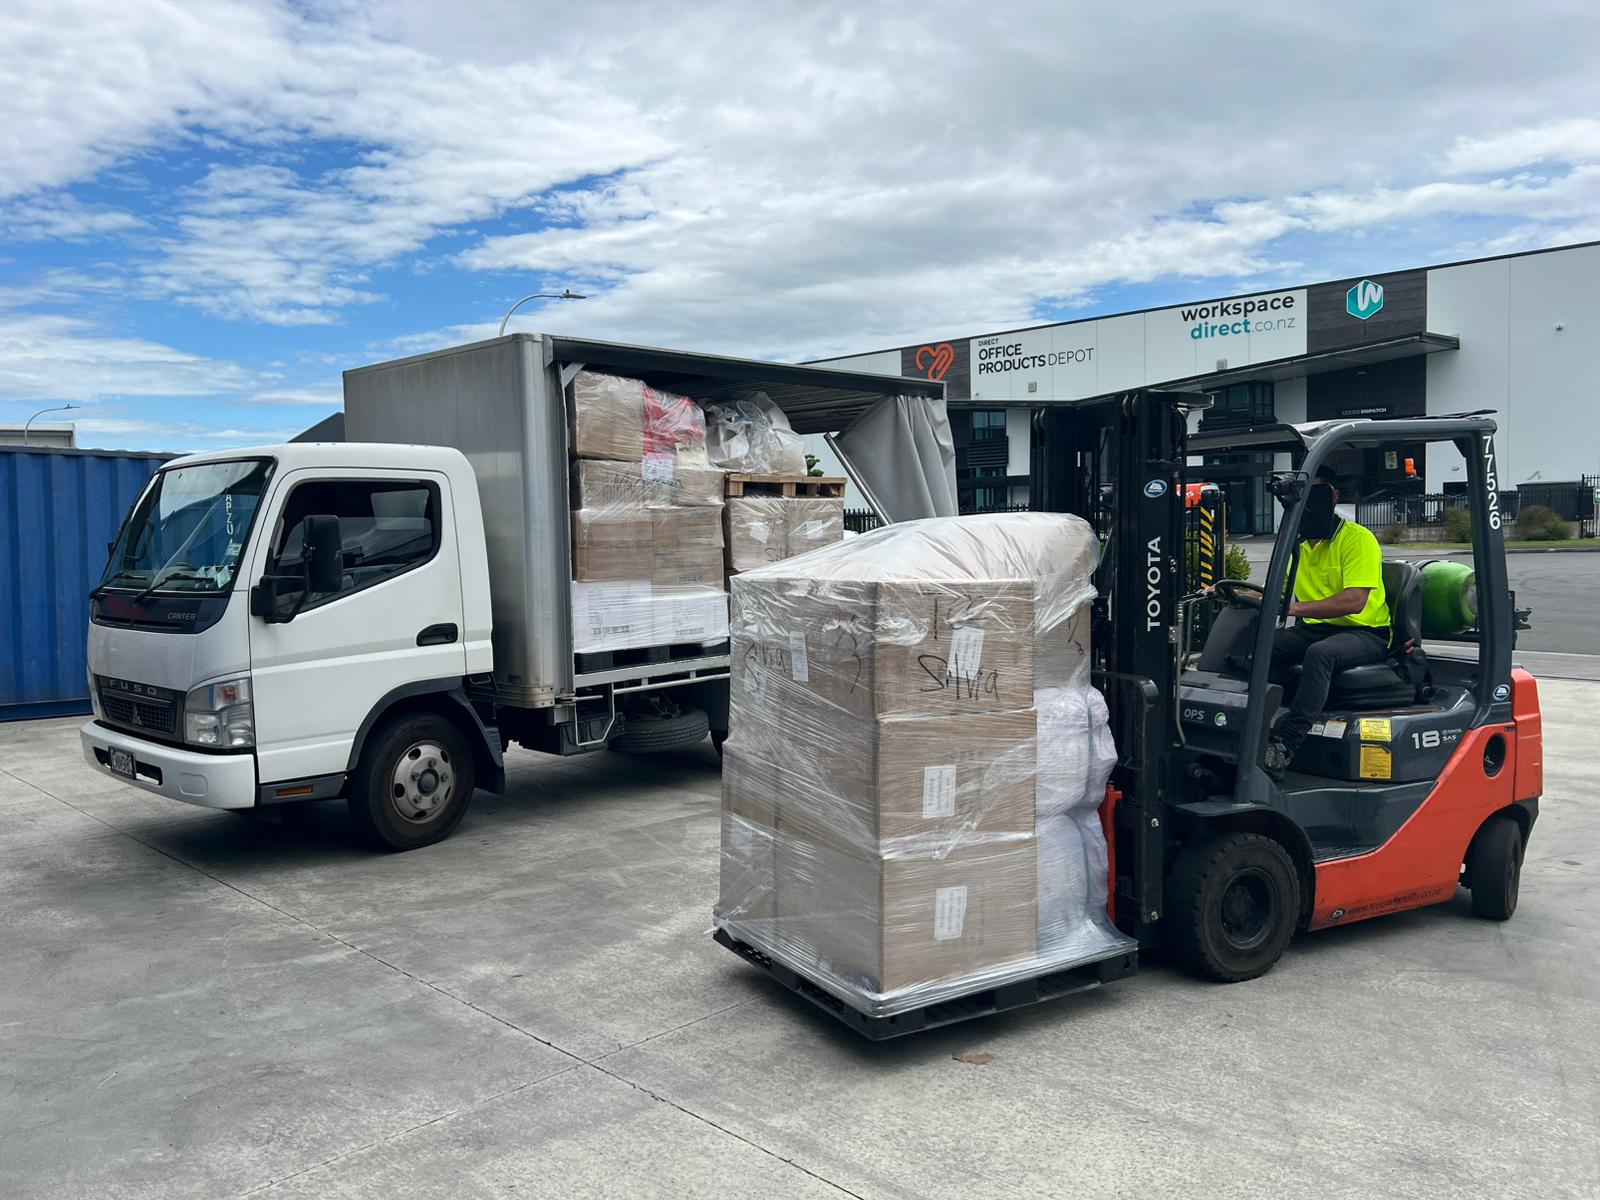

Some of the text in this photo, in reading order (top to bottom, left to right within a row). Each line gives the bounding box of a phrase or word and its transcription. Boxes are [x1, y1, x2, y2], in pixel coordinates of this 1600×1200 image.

[1181, 296, 1295, 321] workspace
[1190, 317, 1295, 340] direct.co.nz
[978, 338, 999, 347] DIRECT
[978, 343, 1022, 361] OFFICE
[978, 347, 1095, 375] PRODUCTS DEPOT
[1360, 407, 1387, 415] DISPATCH
[1482, 435, 1501, 530] 77526
[1147, 536, 1161, 632] TOYOTA
[167, 612, 197, 621] CANTER
[110, 680, 157, 696] FUSO
[1183, 708, 1205, 720] OPS
[1411, 730, 1440, 750] 18
